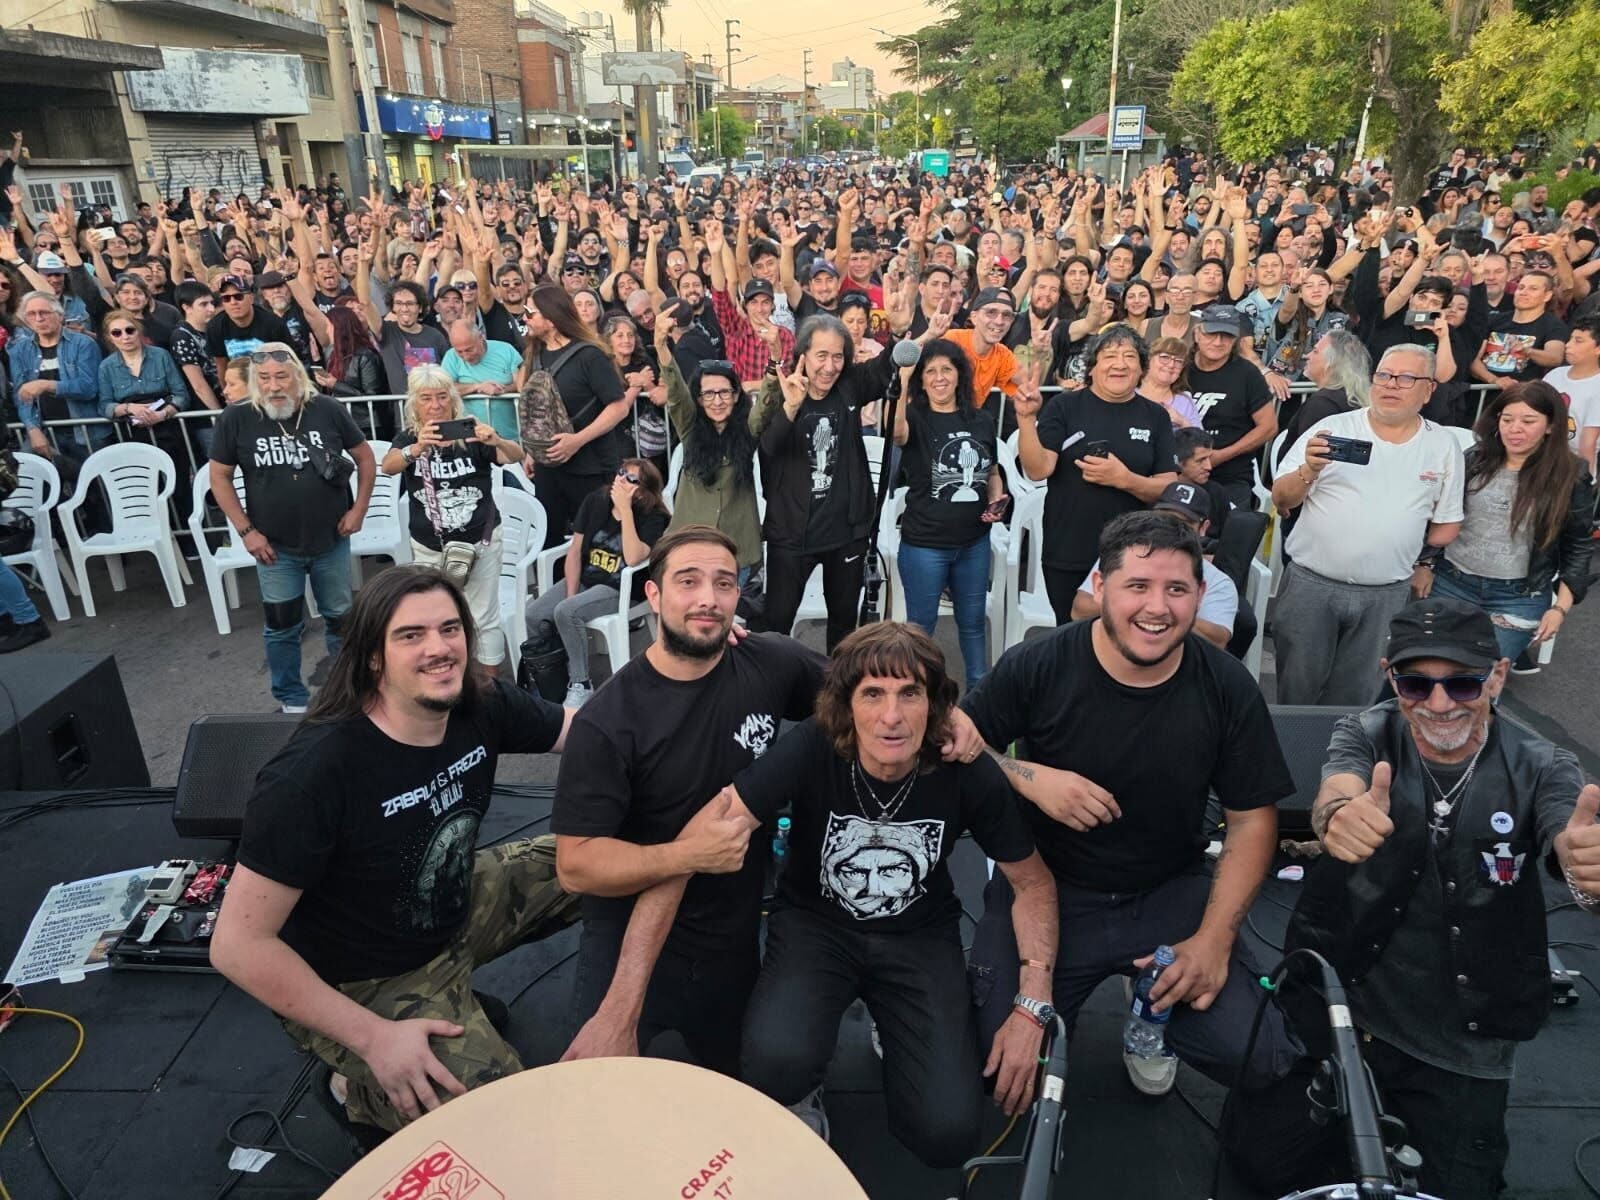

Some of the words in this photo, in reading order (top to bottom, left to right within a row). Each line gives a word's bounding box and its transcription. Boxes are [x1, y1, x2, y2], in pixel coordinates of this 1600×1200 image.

[430, 457, 476, 479] RELOJ
[381, 779, 437, 817] ZABALA
[447, 745, 487, 780] FREZA
[681, 1149, 734, 1199] CRASH
